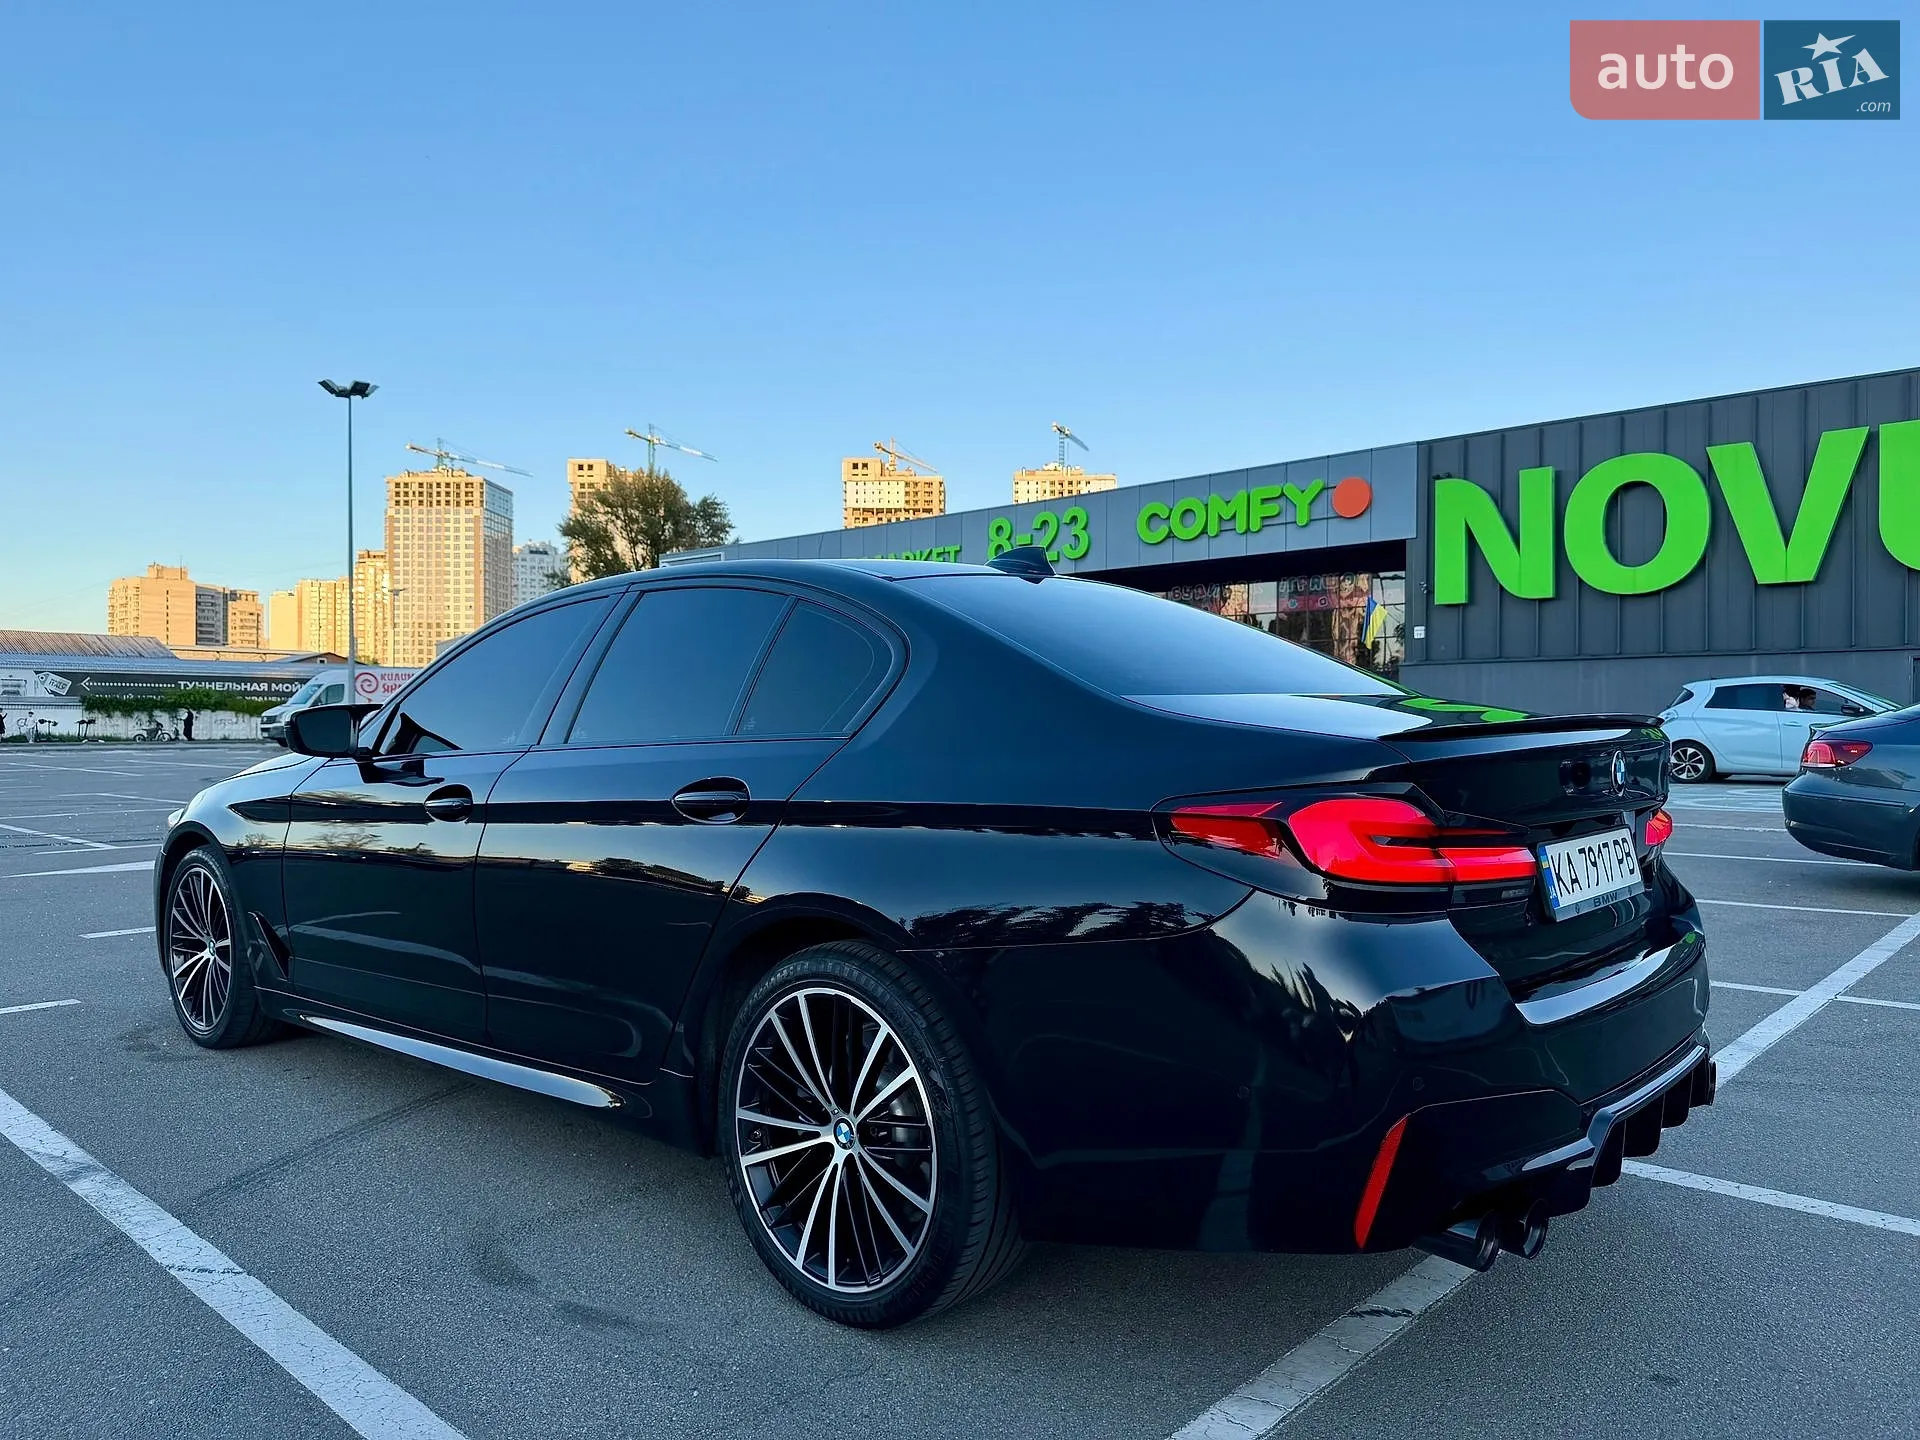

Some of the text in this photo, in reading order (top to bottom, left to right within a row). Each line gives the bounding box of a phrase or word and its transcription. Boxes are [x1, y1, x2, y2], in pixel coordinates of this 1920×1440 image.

[987, 506, 1091, 561] 8-23
[1137, 479, 1325, 544] COMFY
[178, 680, 305, 693] ТУННЕЛЬНАЯ МОЙ
[1551, 837, 1635, 897] KA 7917 PB
[1593, 891, 1618, 907] BMW
